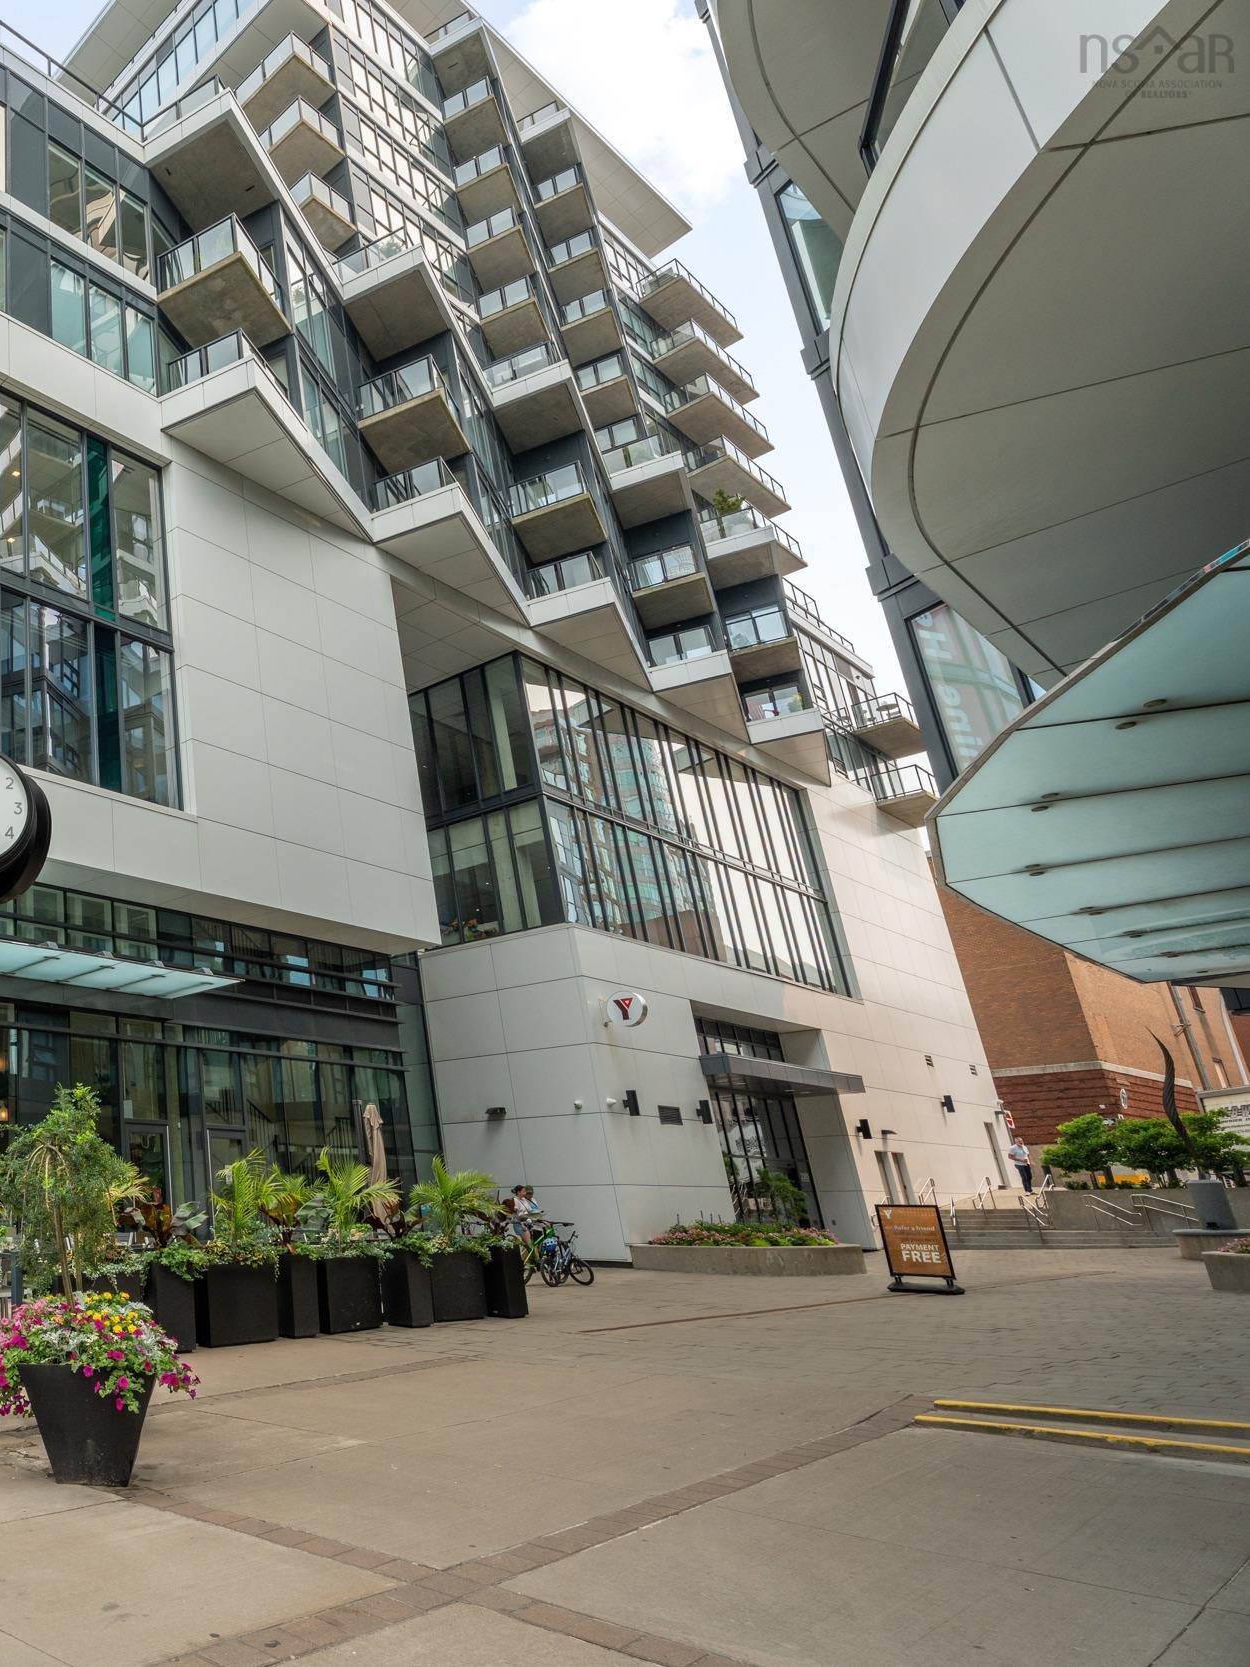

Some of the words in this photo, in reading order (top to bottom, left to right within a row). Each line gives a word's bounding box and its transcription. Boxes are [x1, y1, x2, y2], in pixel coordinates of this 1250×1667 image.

[5, 777, 14, 790] 2
[13, 802, 23, 815] 3
[4, 826, 15, 839] 4
[902, 1251, 941, 1263] FREE
